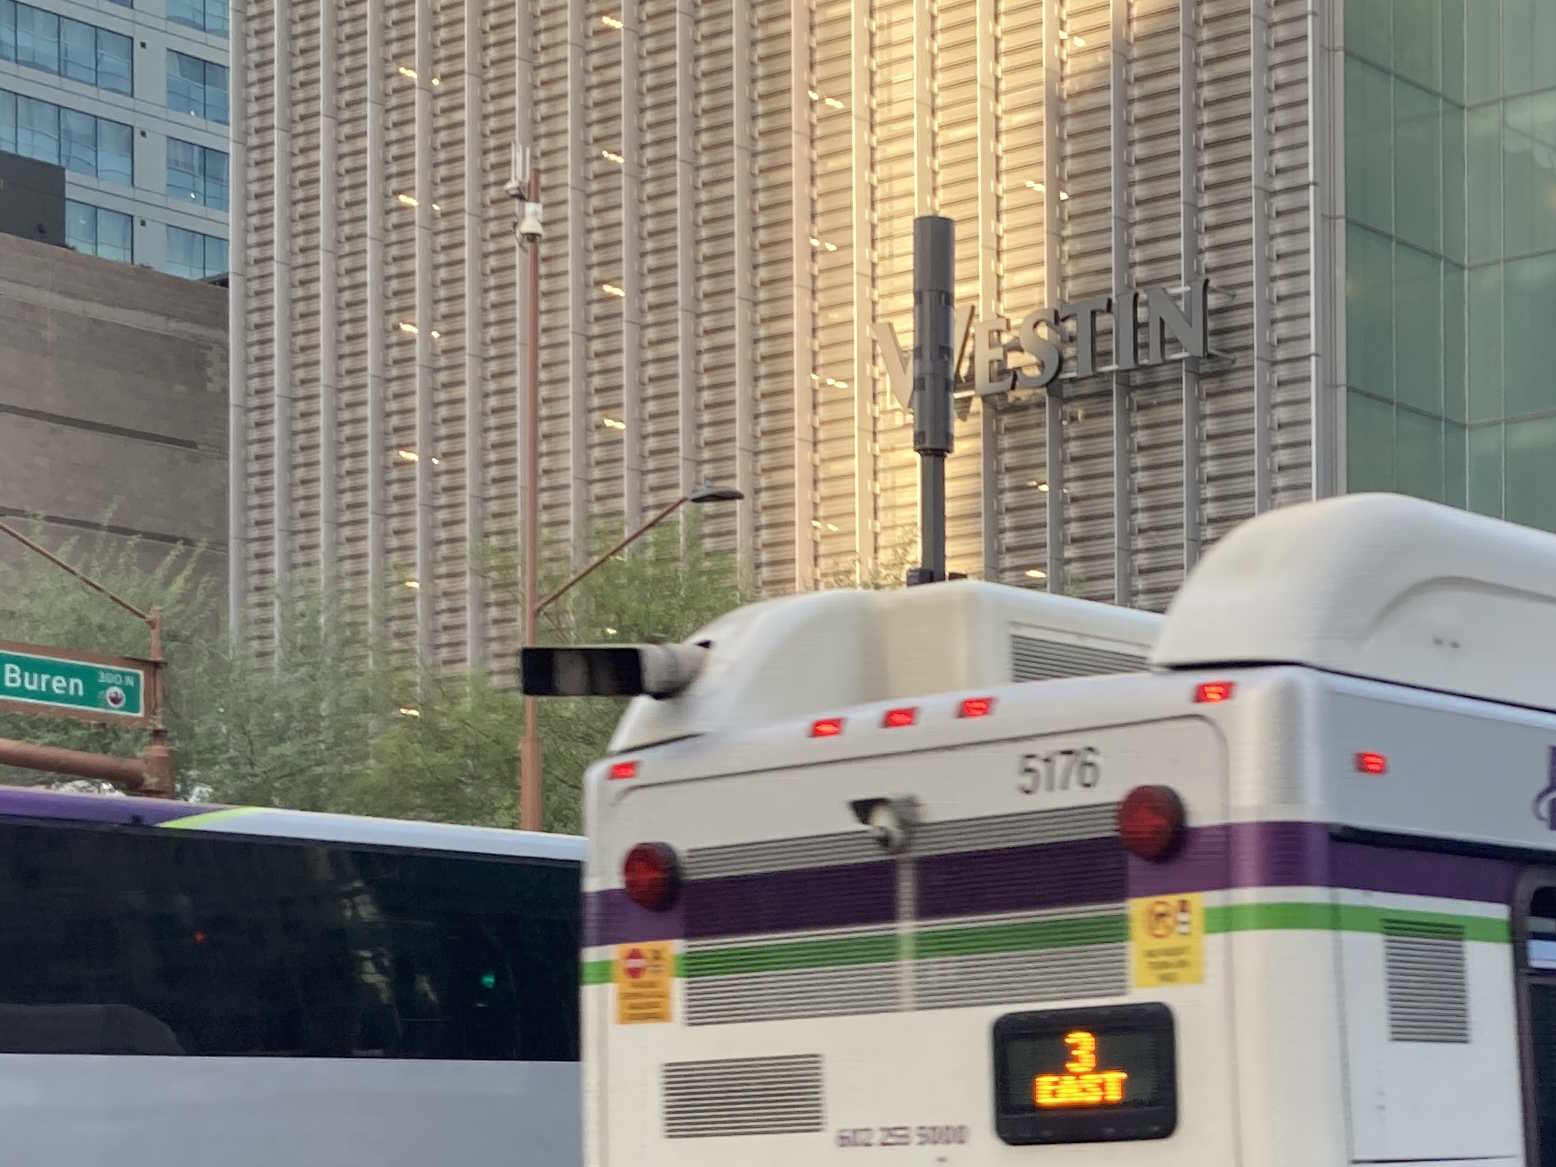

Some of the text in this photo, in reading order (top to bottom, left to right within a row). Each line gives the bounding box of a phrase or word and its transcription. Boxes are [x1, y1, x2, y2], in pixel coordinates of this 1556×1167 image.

[872, 277, 1211, 410] WESTIN
[4, 663, 84, 697] Buren
[1018, 746, 1101, 795] 5176
[1064, 1031, 1096, 1073] 3
[1035, 1071, 1128, 1106] EAST
